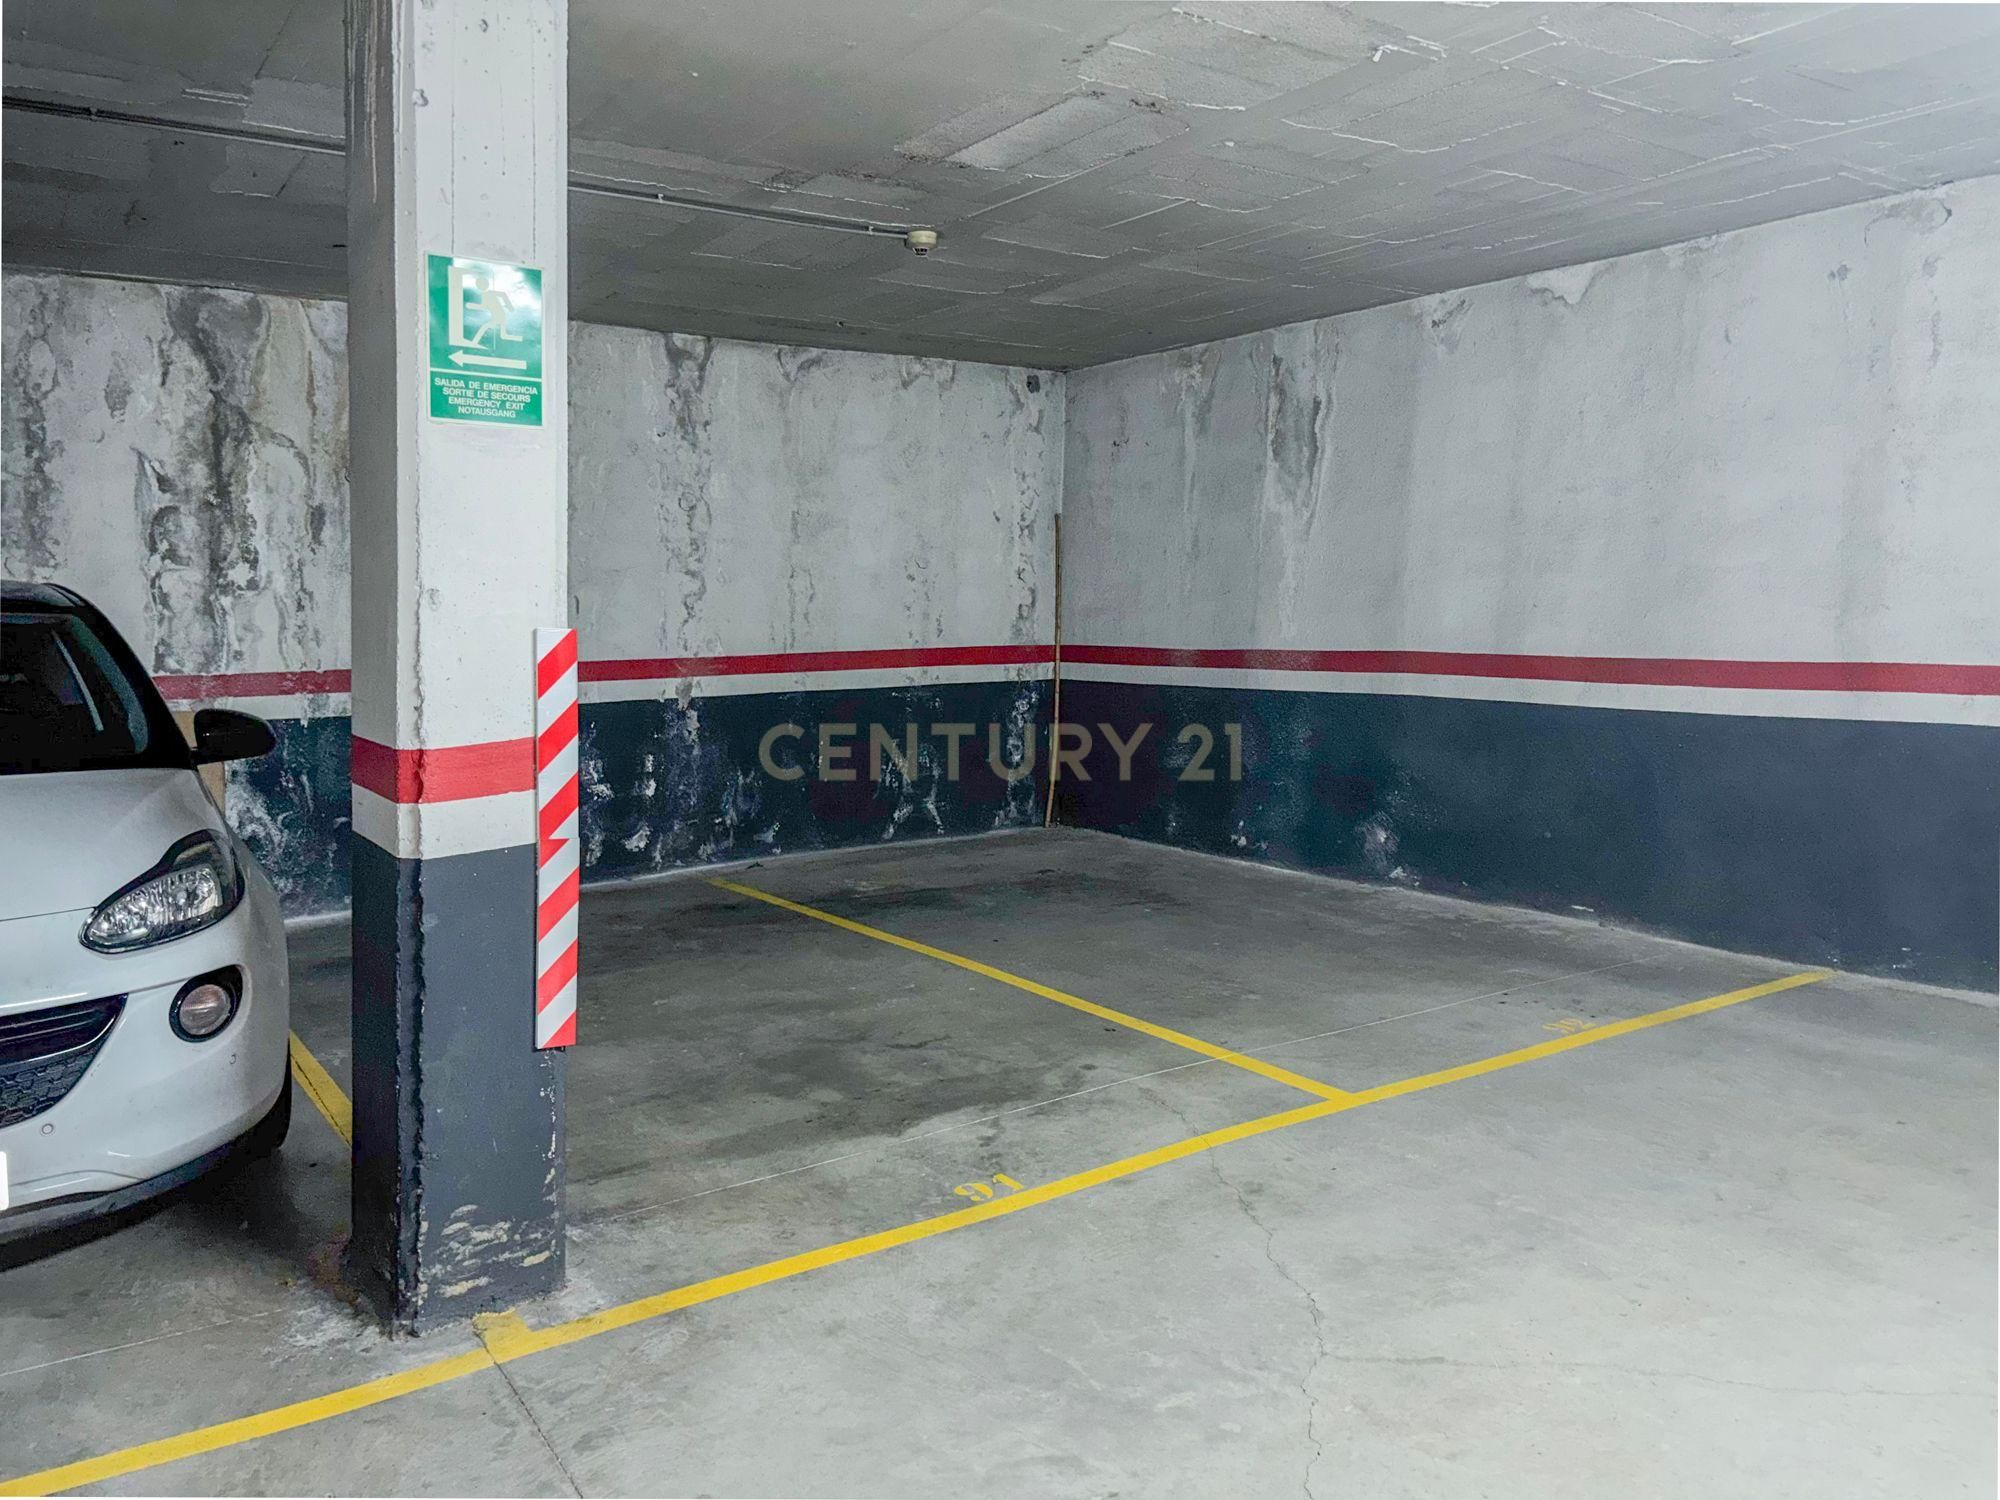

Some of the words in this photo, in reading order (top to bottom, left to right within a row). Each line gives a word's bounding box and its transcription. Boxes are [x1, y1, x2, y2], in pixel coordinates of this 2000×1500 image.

[434, 377, 465, 388] SALIDA
[468, 381, 481, 389] DE
[483, 382, 538, 395] EMERGENCIA
[442, 387, 474, 398] SORTIE
[477, 390, 490, 399] DE
[491, 391, 531, 403] SECOURS
[448, 396, 501, 408] EMERGENCY
[505, 402, 525, 411] EXIT
[458, 406, 517, 418] NOTAUSGANG
[954, 1173, 1024, 1202] 91
